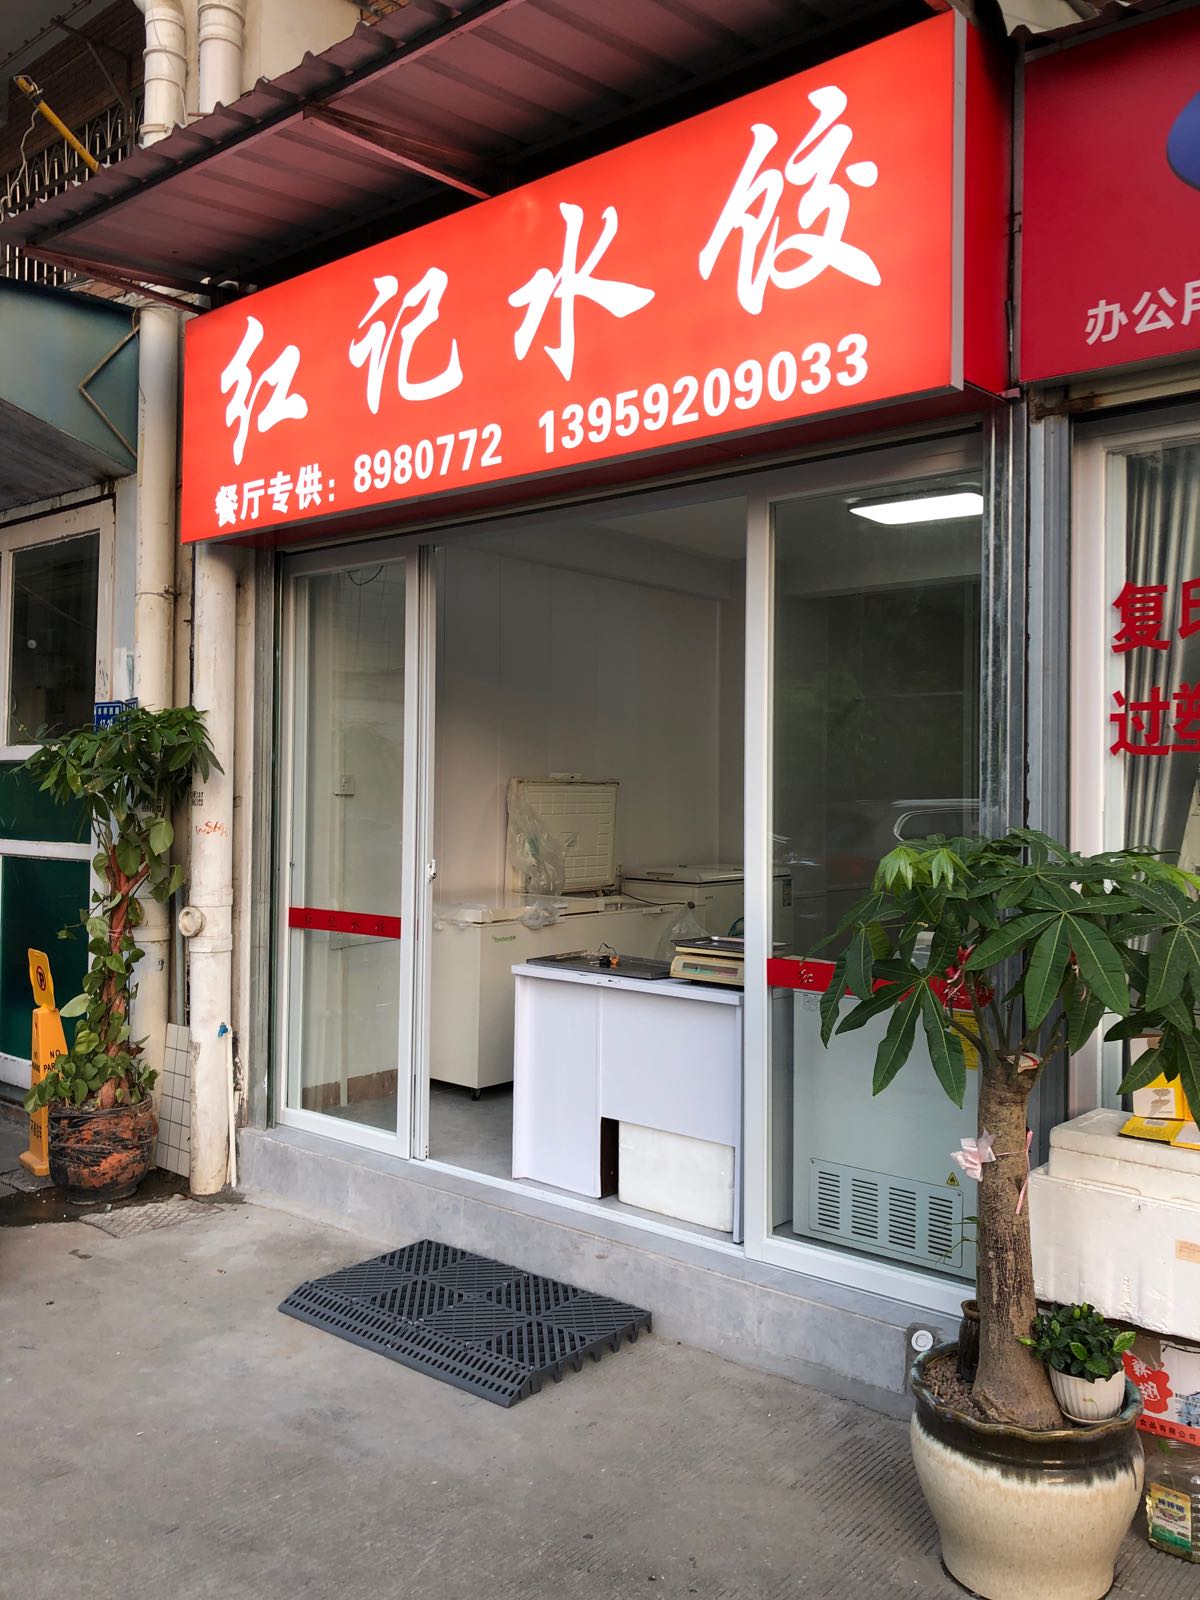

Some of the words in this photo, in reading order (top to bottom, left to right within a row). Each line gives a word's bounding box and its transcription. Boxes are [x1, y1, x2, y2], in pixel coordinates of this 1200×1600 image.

[219, 86, 881, 466] 红记水饺
[353, 423, 503, 493] 8980772
[538, 333, 869, 454] 13959209033
